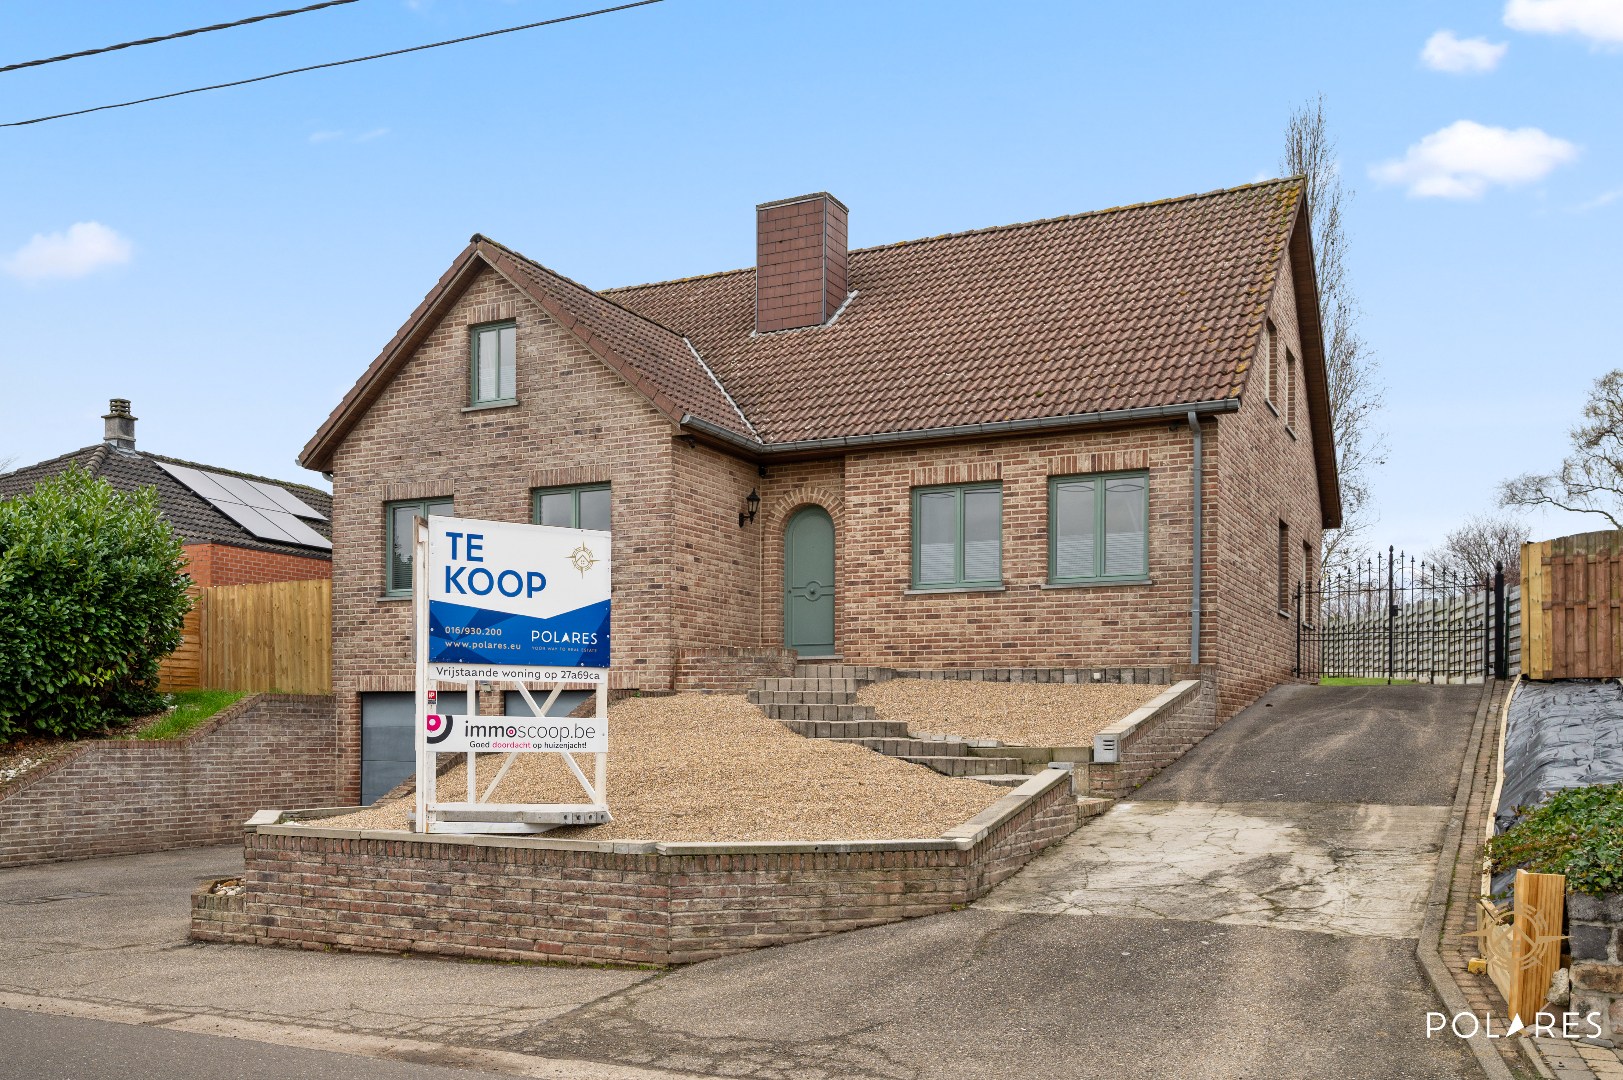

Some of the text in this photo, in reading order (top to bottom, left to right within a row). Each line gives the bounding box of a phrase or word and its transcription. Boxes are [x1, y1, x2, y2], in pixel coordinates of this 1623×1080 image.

[446, 532, 484, 562] TE
[445, 565, 547, 598] KOOP
[445, 626, 502, 636] 016/930.200
[531, 630, 598, 645] POLARES
[445, 641, 521, 650] www.polares.eu
[436, 666, 600, 680] Vrijstaande woning op 27a69ca
[465, 720, 596, 742] immoscoop.be
[492, 741, 531, 749] doordacht
[544, 742, 587, 750] huizenjacht!
